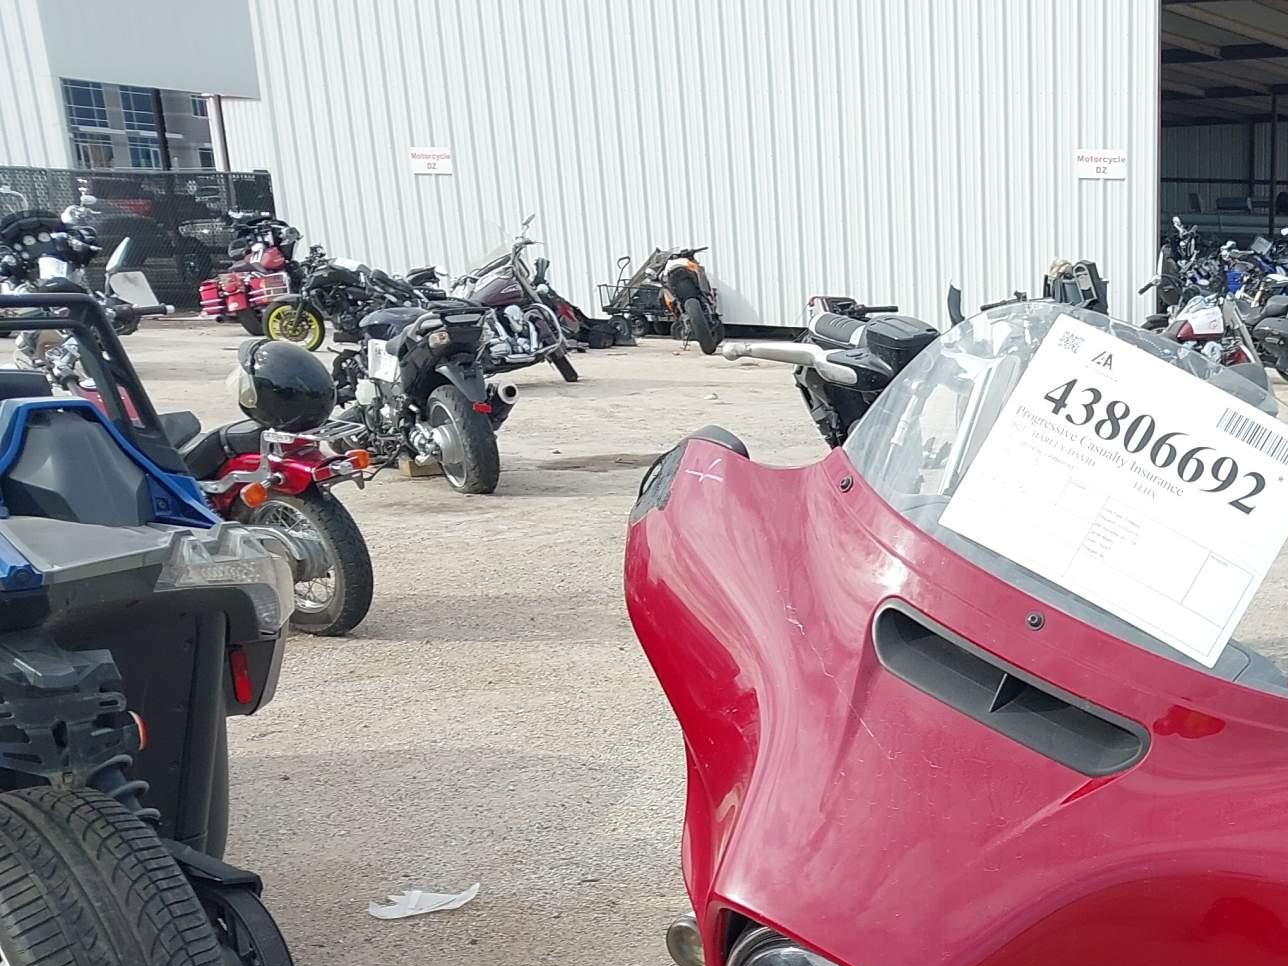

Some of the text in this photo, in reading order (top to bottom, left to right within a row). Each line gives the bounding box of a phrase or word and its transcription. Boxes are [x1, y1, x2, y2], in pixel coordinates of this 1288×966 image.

[410, 152, 450, 161] Motorcycle
[1077, 155, 1126, 164] Motorcycle
[1016, 405, 1078, 442] Progressive
[1080, 435, 1127, 468] Casualty
[1130, 461, 1184, 497] Insurance
[1043, 378, 1267, 515] 43806692
